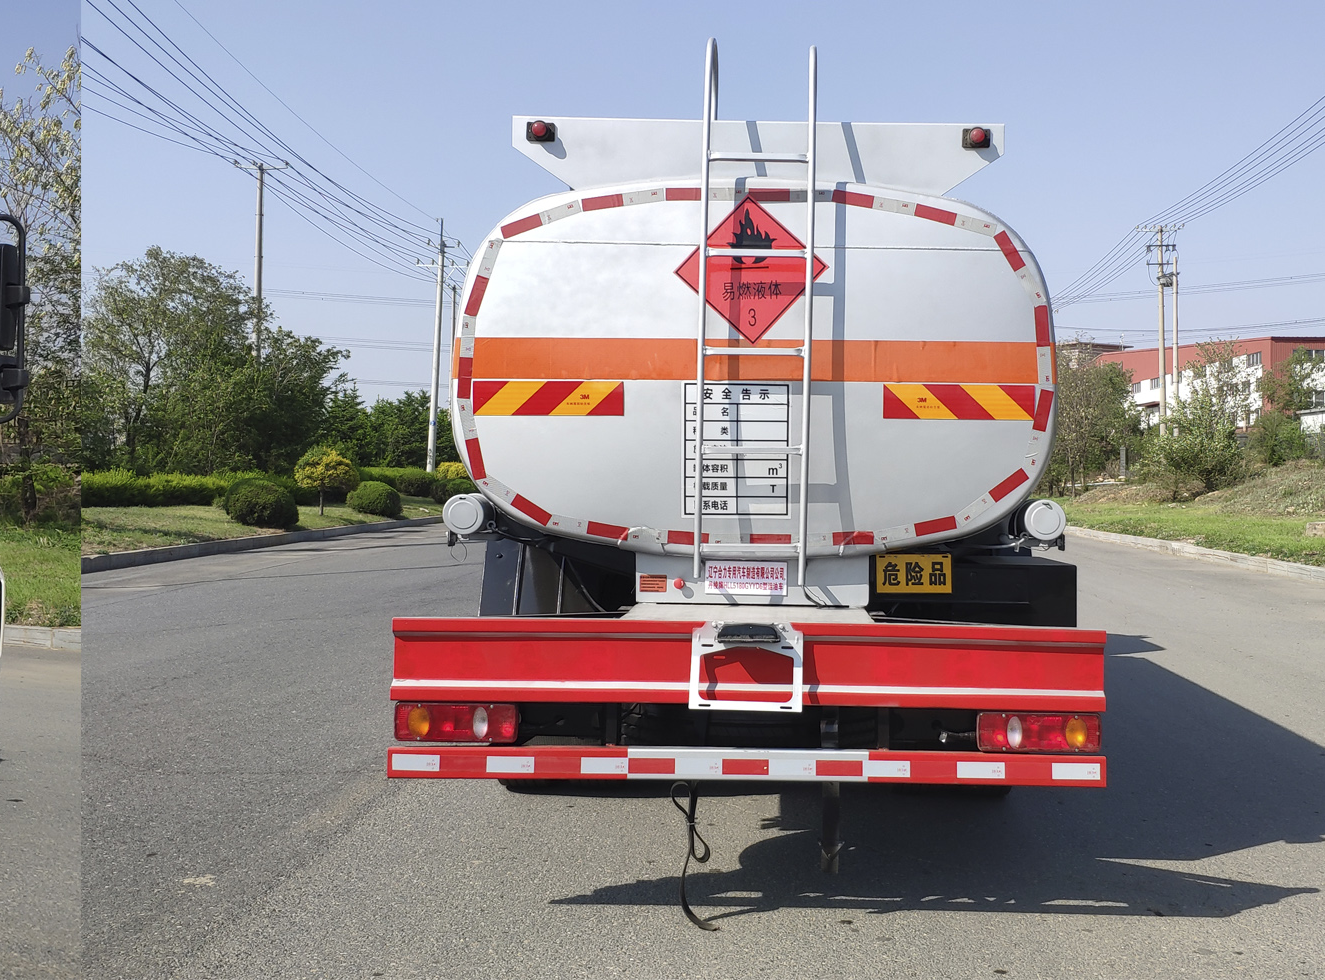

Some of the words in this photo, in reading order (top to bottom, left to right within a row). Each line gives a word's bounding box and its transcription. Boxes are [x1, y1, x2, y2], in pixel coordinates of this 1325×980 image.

[722, 280, 782, 301] 易燃液体
[748, 308, 757, 327] 3
[703, 388, 770, 400] 安全告示
[721, 407, 729, 417] 名
[720, 426, 729, 436] 类
[693, 464, 729, 473] 体容积
[693, 482, 728, 491] 载质量
[770, 484, 777, 494] T
[694, 500, 729, 511] 系电话
[882, 561, 947, 586] 危险品
